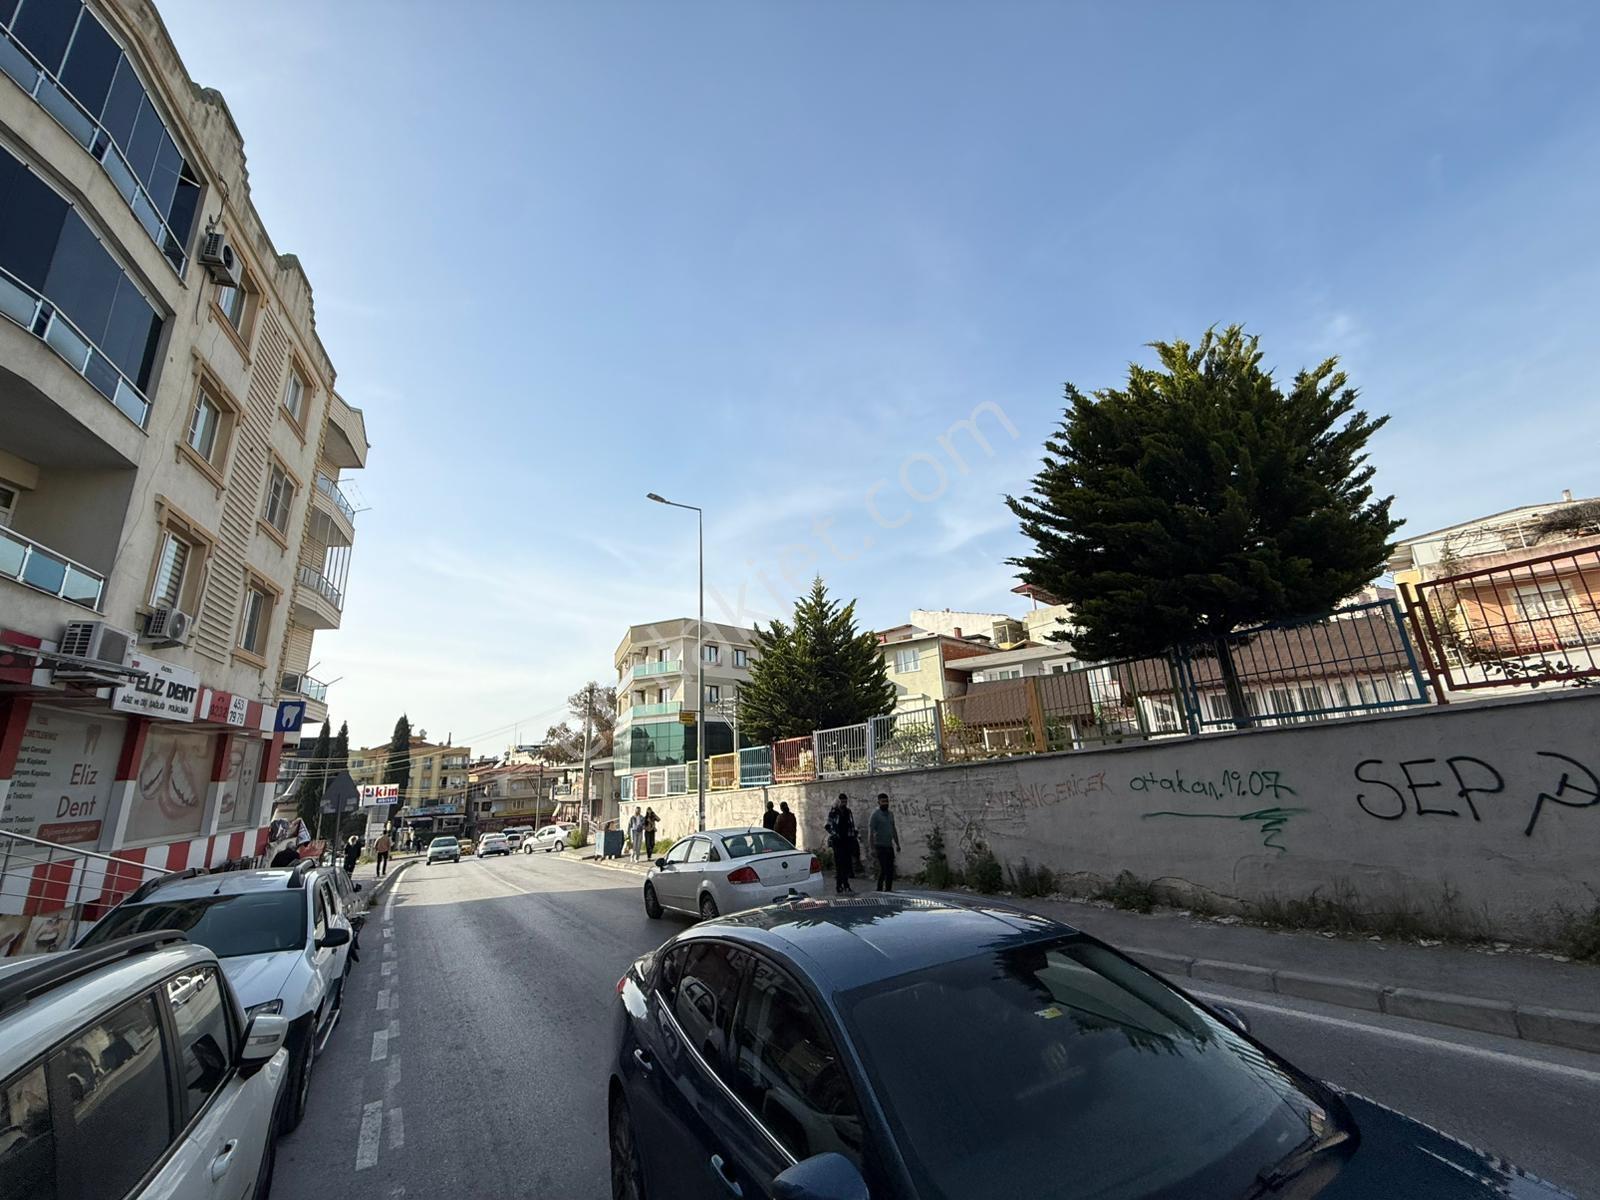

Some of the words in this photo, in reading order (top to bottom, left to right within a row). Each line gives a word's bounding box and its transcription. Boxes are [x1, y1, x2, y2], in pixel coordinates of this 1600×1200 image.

[135, 673, 165, 696] ELİZ
[166, 681, 197, 704] DENT
[233, 698, 245, 711] 453
[69, 764, 98, 785] Eliz
[375, 786, 398, 798] kim
[1354, 755, 1506, 822] SEP
[56, 796, 96, 818] Dent
